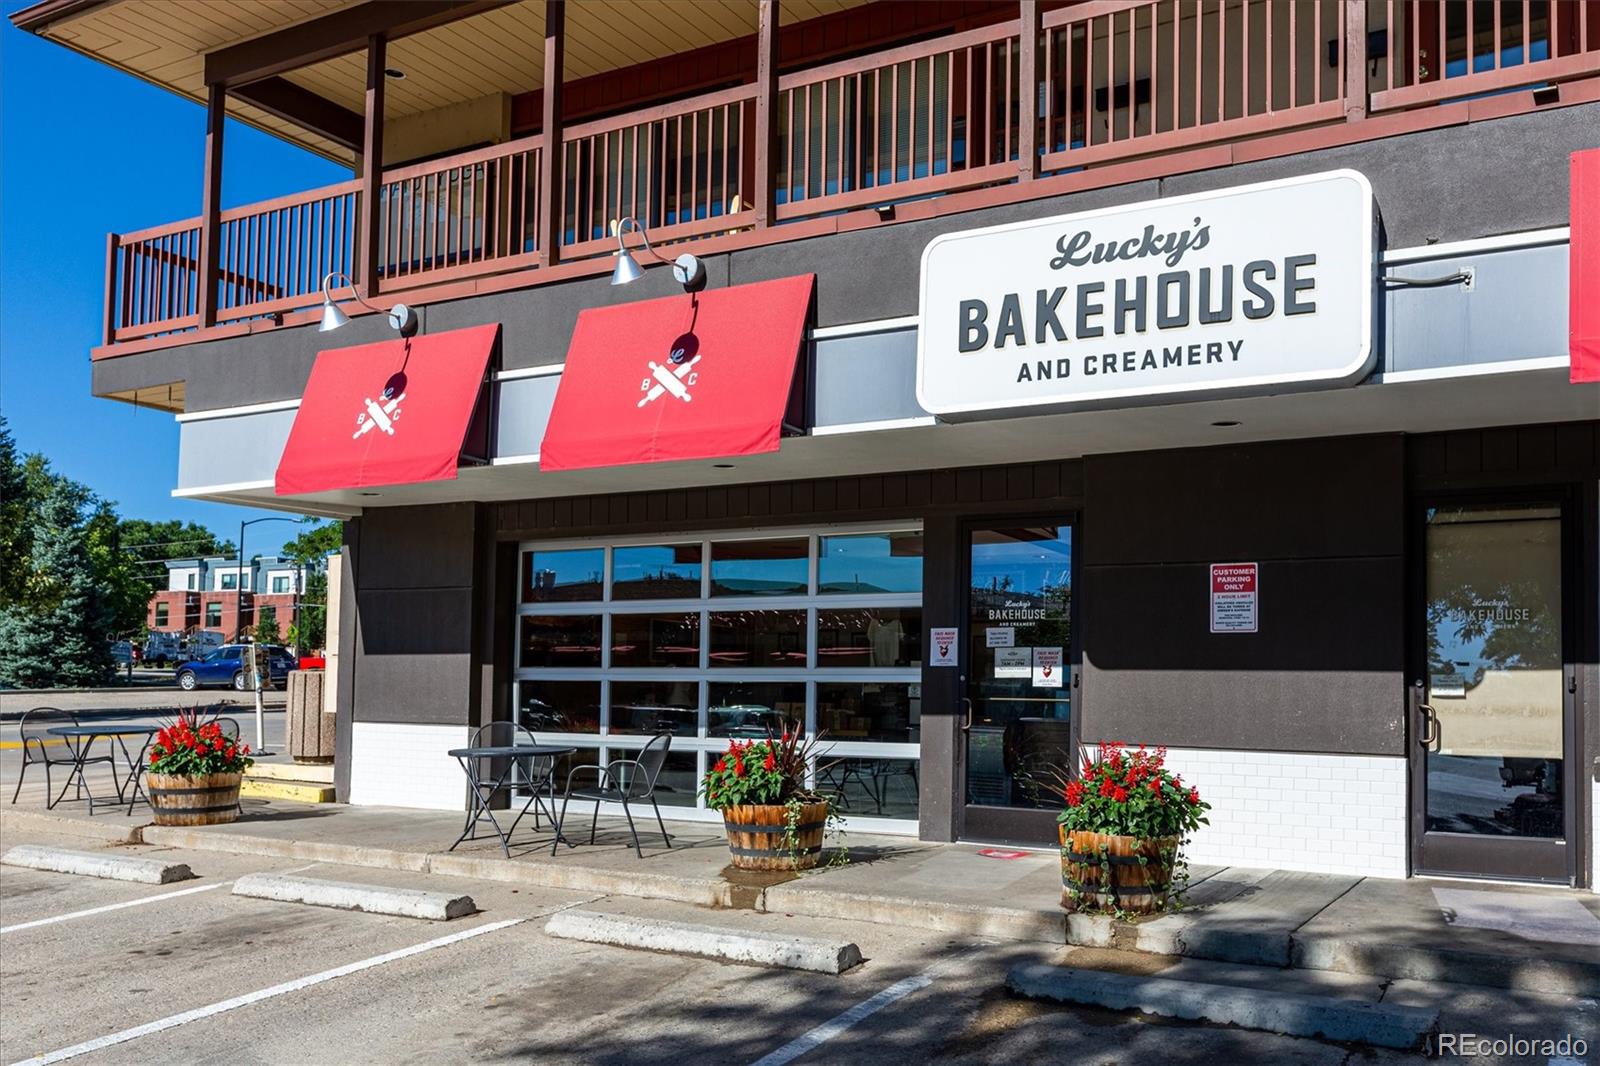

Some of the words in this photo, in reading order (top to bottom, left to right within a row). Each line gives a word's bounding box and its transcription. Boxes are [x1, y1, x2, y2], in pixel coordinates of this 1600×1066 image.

[1050, 216, 1211, 270] Lucky's
[957, 253, 1318, 354] BAKEHOUSE
[1016, 357, 1071, 383] AND
[1083, 339, 1244, 376] CREAMERY
[640, 378, 651, 391] B
[687, 372, 698, 386] C
[356, 412, 366, 425] B
[1004, 599, 1031, 609] Lucky's
[1472, 598, 1509, 609] Lucky's
[988, 608, 1046, 620] BAKEHOUSE
